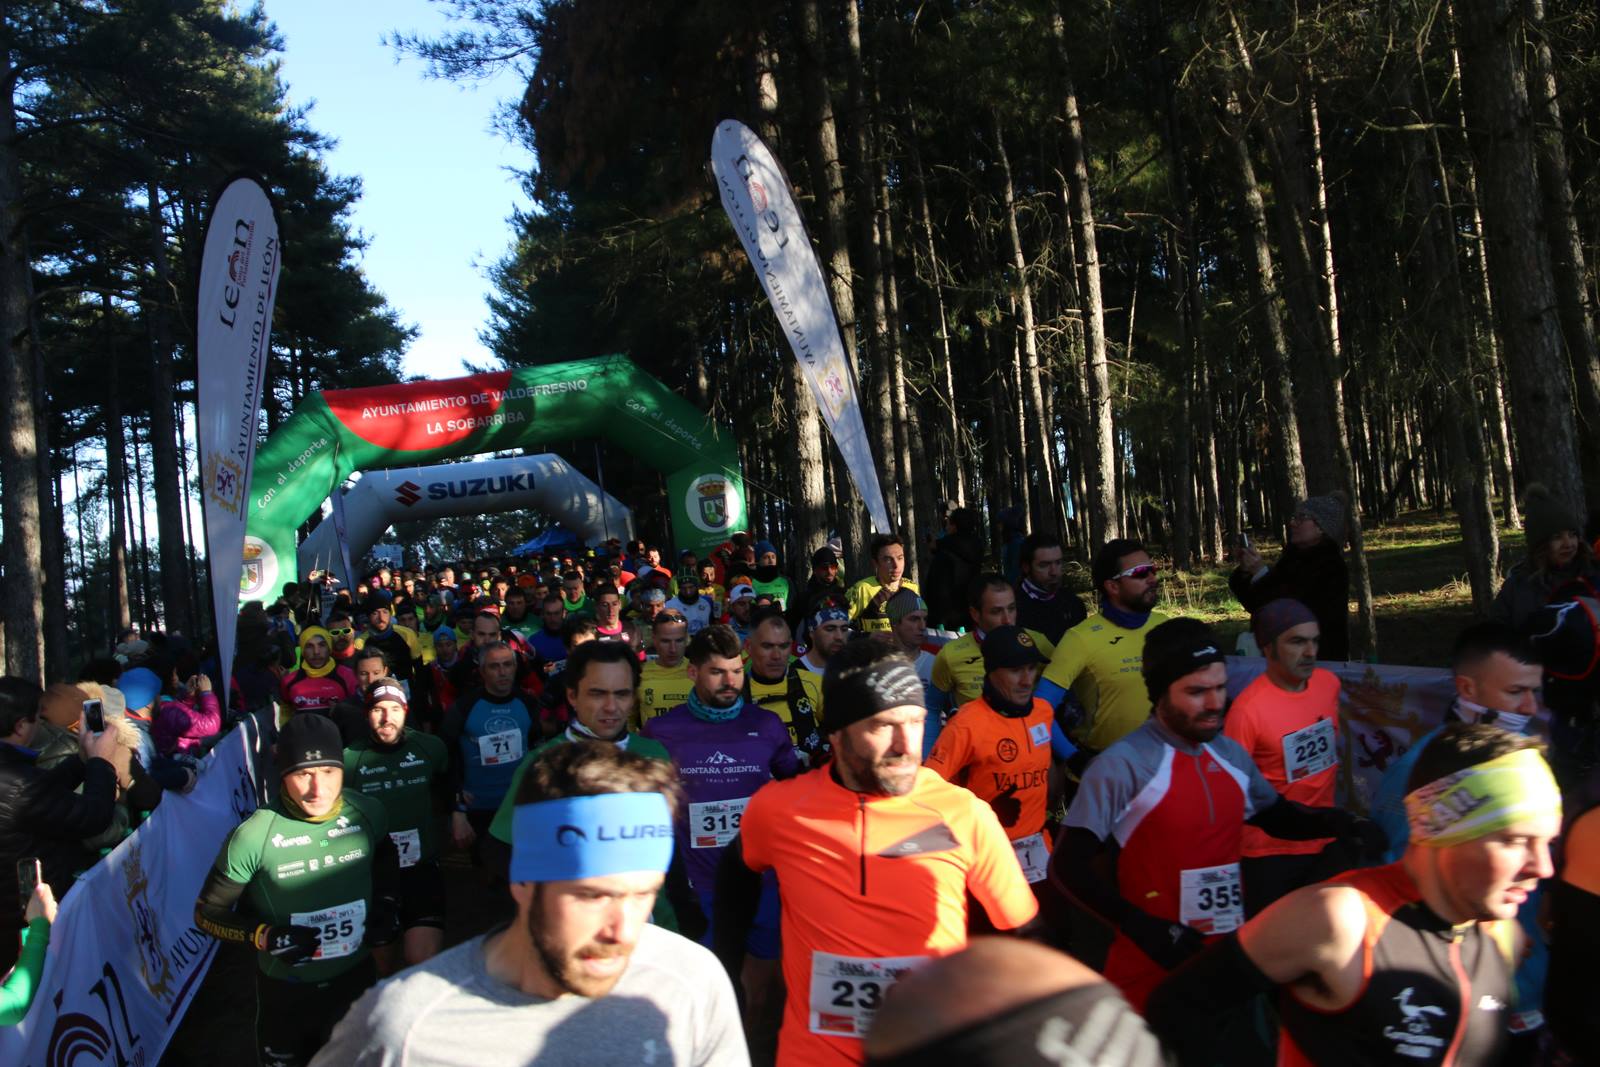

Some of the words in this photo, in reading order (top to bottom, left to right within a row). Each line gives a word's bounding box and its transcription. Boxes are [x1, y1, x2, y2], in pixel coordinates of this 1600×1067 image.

[261, 236, 275, 286] LEÓN
[257, 291, 266, 315] DE
[237, 320, 262, 460] AYUNTAMIENTO
[362, 395, 468, 419] AYUNTAMIENTO
[470, 393, 489, 405] DE
[492, 379, 588, 401] VALDEFRESNO
[427, 423, 444, 435] LA
[446, 411, 526, 432] SOBARRIBA
[624, 399, 647, 413] Con
[651, 411, 661, 420] el
[664, 416, 702, 450] deporte
[257, 486, 276, 509] Con
[277, 472, 288, 486] el
[288, 437, 328, 474] deporte
[427, 473, 536, 500] SUZUKI
[492, 741, 509, 754] 71
[1295, 735, 1329, 763] 223
[680, 766, 720, 774] MONTAÑA
[723, 764, 761, 774] ORIENTAL
[703, 812, 743, 831] 313
[400, 842, 410, 854] 7
[1025, 851, 1031, 866] 1
[1197, 883, 1241, 911] 355
[170, 927, 209, 974] AYUN
